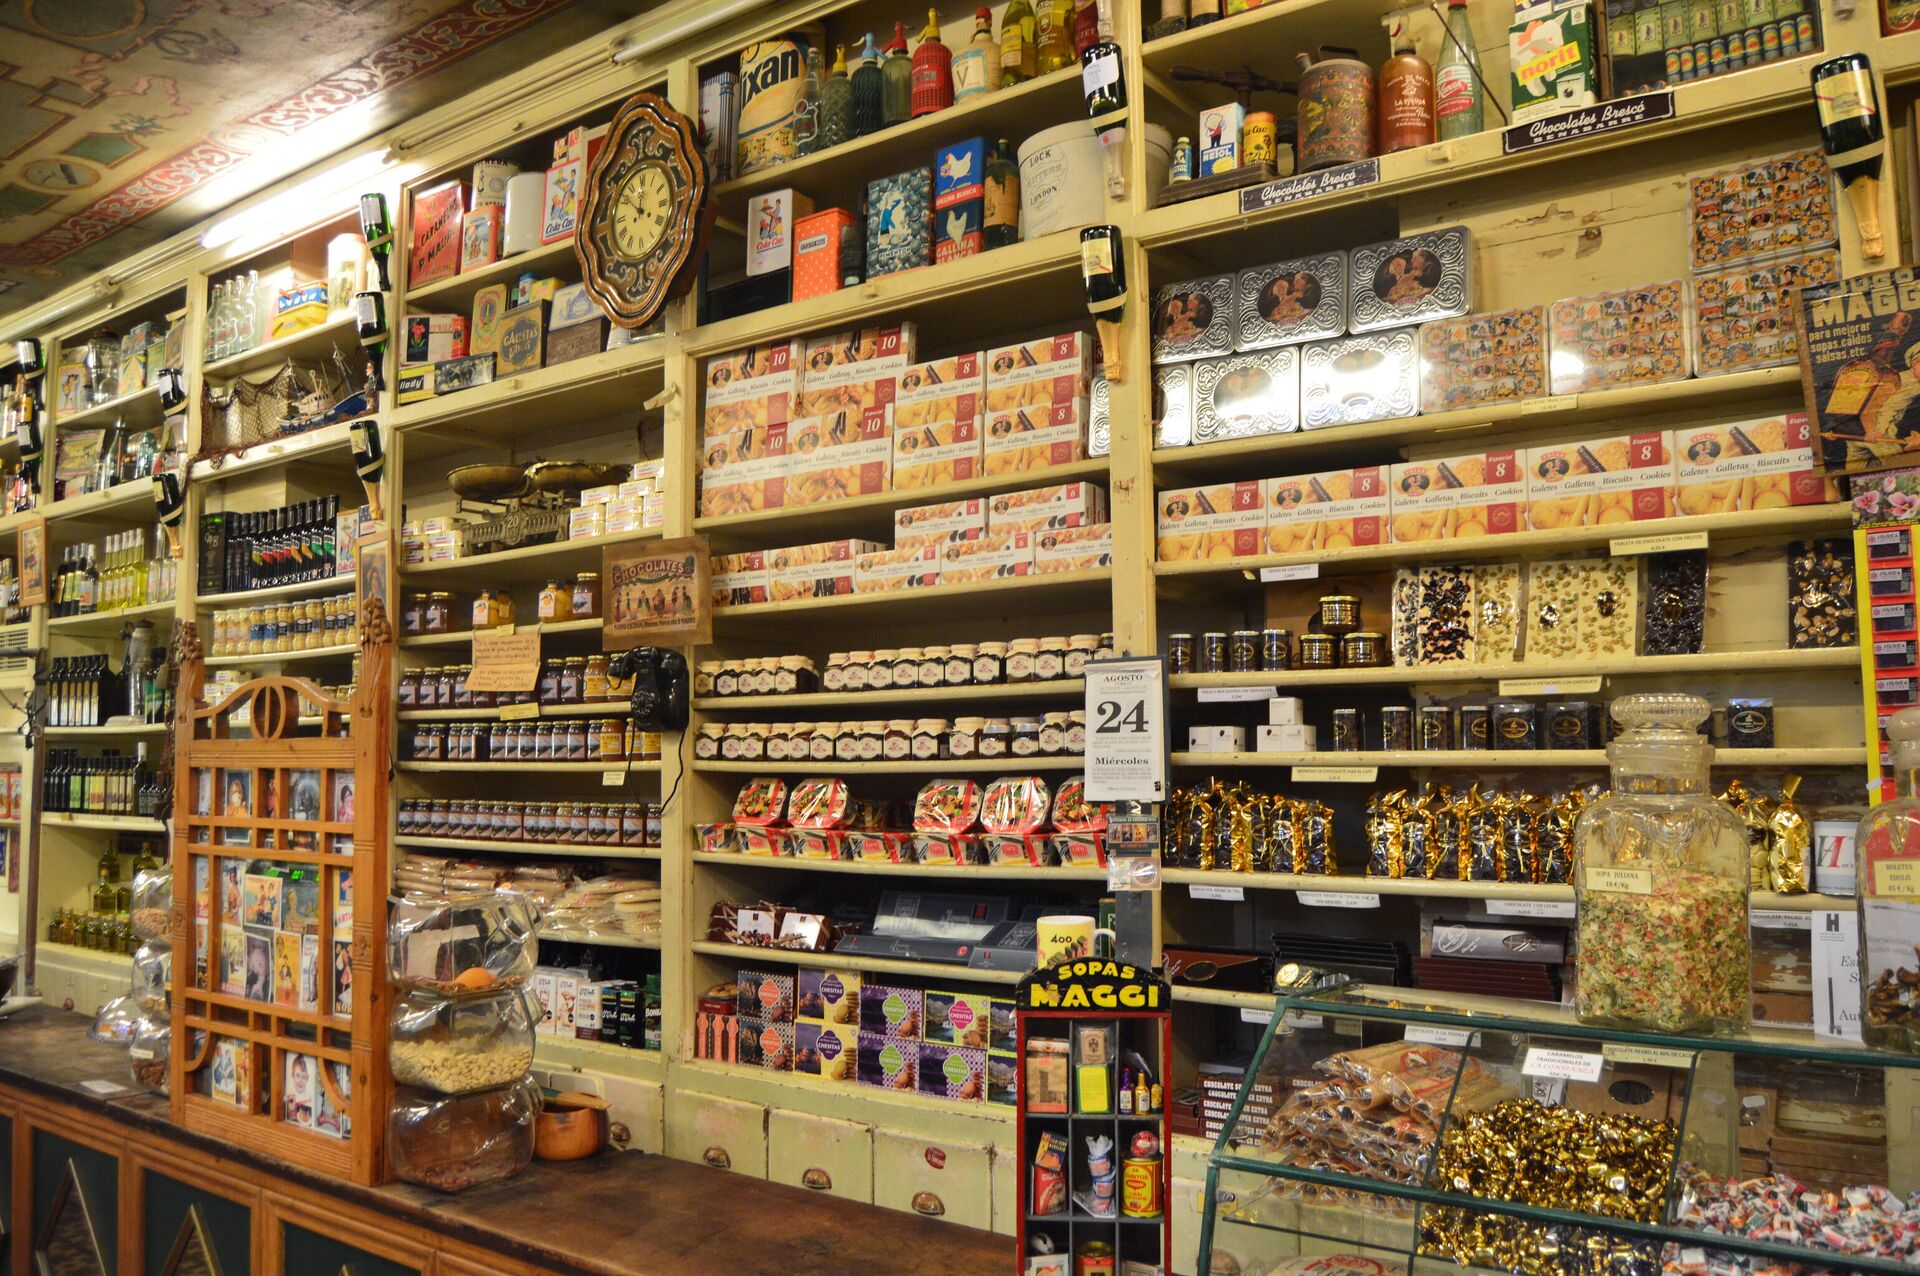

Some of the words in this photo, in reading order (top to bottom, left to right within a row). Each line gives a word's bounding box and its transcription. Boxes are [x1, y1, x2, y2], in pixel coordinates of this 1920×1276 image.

[1521, 46, 1576, 81] norit
[1529, 109, 1597, 138] Chocolates
[1601, 101, 1646, 122] Brescó
[1252, 126, 1267, 134] Cao
[1533, 114, 1645, 143] BENABARRE
[1030, 149, 1051, 167] LOCK
[1261, 176, 1316, 200] Chocolates
[1320, 169, 1356, 186] Brescó
[1031, 186, 1057, 206] LONDON
[545, 220, 561, 235] Cola
[562, 217, 575, 228] Cao
[756, 240, 770, 250] Cola
[770, 237, 784, 246] Cao
[1809, 328, 1830, 342] para
[1832, 322, 1871, 339] mejorar
[881, 336, 896, 350] 10
[1842, 334, 1872, 350] caldos
[1060, 343, 1067, 355] 8
[772, 352, 786, 366] 10
[880, 361, 902, 370] Cookies
[963, 362, 970, 374] 8
[1059, 362, 1080, 371] Cookies
[1058, 408, 1065, 420] 8
[866, 418, 880, 433] 10
[961, 425, 968, 437] 8
[1799, 425, 1810, 440] 8
[770, 436, 783, 450] 10
[1632, 436, 1659, 445] Especial
[1641, 445, 1652, 460] 8
[1495, 462, 1505, 477] 8
[1680, 467, 1709, 477] Galetes
[1715, 463, 1749, 473] Galletas
[1757, 457, 1791, 467] Biscuits
[1361, 478, 1371, 491] 8
[1531, 484, 1558, 493] Galetes
[1564, 480, 1595, 489] Galletas
[1602, 476, 1633, 485] Biscuits
[1640, 470, 1671, 480] Cookies
[1242, 491, 1250, 504] 8
[1394, 499, 1419, 507] Galetes
[1425, 495, 1453, 503] Galletas
[1460, 492, 1488, 500] Biscuits
[1494, 488, 1523, 496] Cookies
[1297, 508, 1323, 516] Galletas
[1329, 505, 1354, 513] Biscuits
[1360, 502, 1386, 510] Cookies
[507, 516, 518, 528] 20
[1184, 520, 1208, 528] Galletas
[1212, 517, 1236, 525] Biscuits
[614, 561, 684, 583] CHOCOLATES
[1103, 674, 1143, 683] AGOSTO
[1095, 699, 1149, 734] 24
[1095, 756, 1149, 765] Miércoles
[1614, 872, 1639, 880] JULIANA
[1826, 913, 1840, 932] H
[1051, 934, 1073, 944] 400
[1058, 961, 1136, 980] SOPAS
[1030, 983, 1159, 1008] MAGGI
[950, 1012, 972, 1020] CHESITAS
[1537, 1057, 1582, 1065] TRADICIONALES
[1547, 1051, 1583, 1059] CARAMELOS
[944, 1066, 967, 1074] CHESITAS
[1203, 1080, 1234, 1090] CHOCOLATE
[1254, 1085, 1272, 1093] EXTRA
[1208, 1090, 1237, 1099] CHOCOLATE
[1255, 1095, 1273, 1103] EXTRA
[1203, 1100, 1232, 1109] CHOCOLATE
[1252, 1116, 1269, 1124] EXTRA
